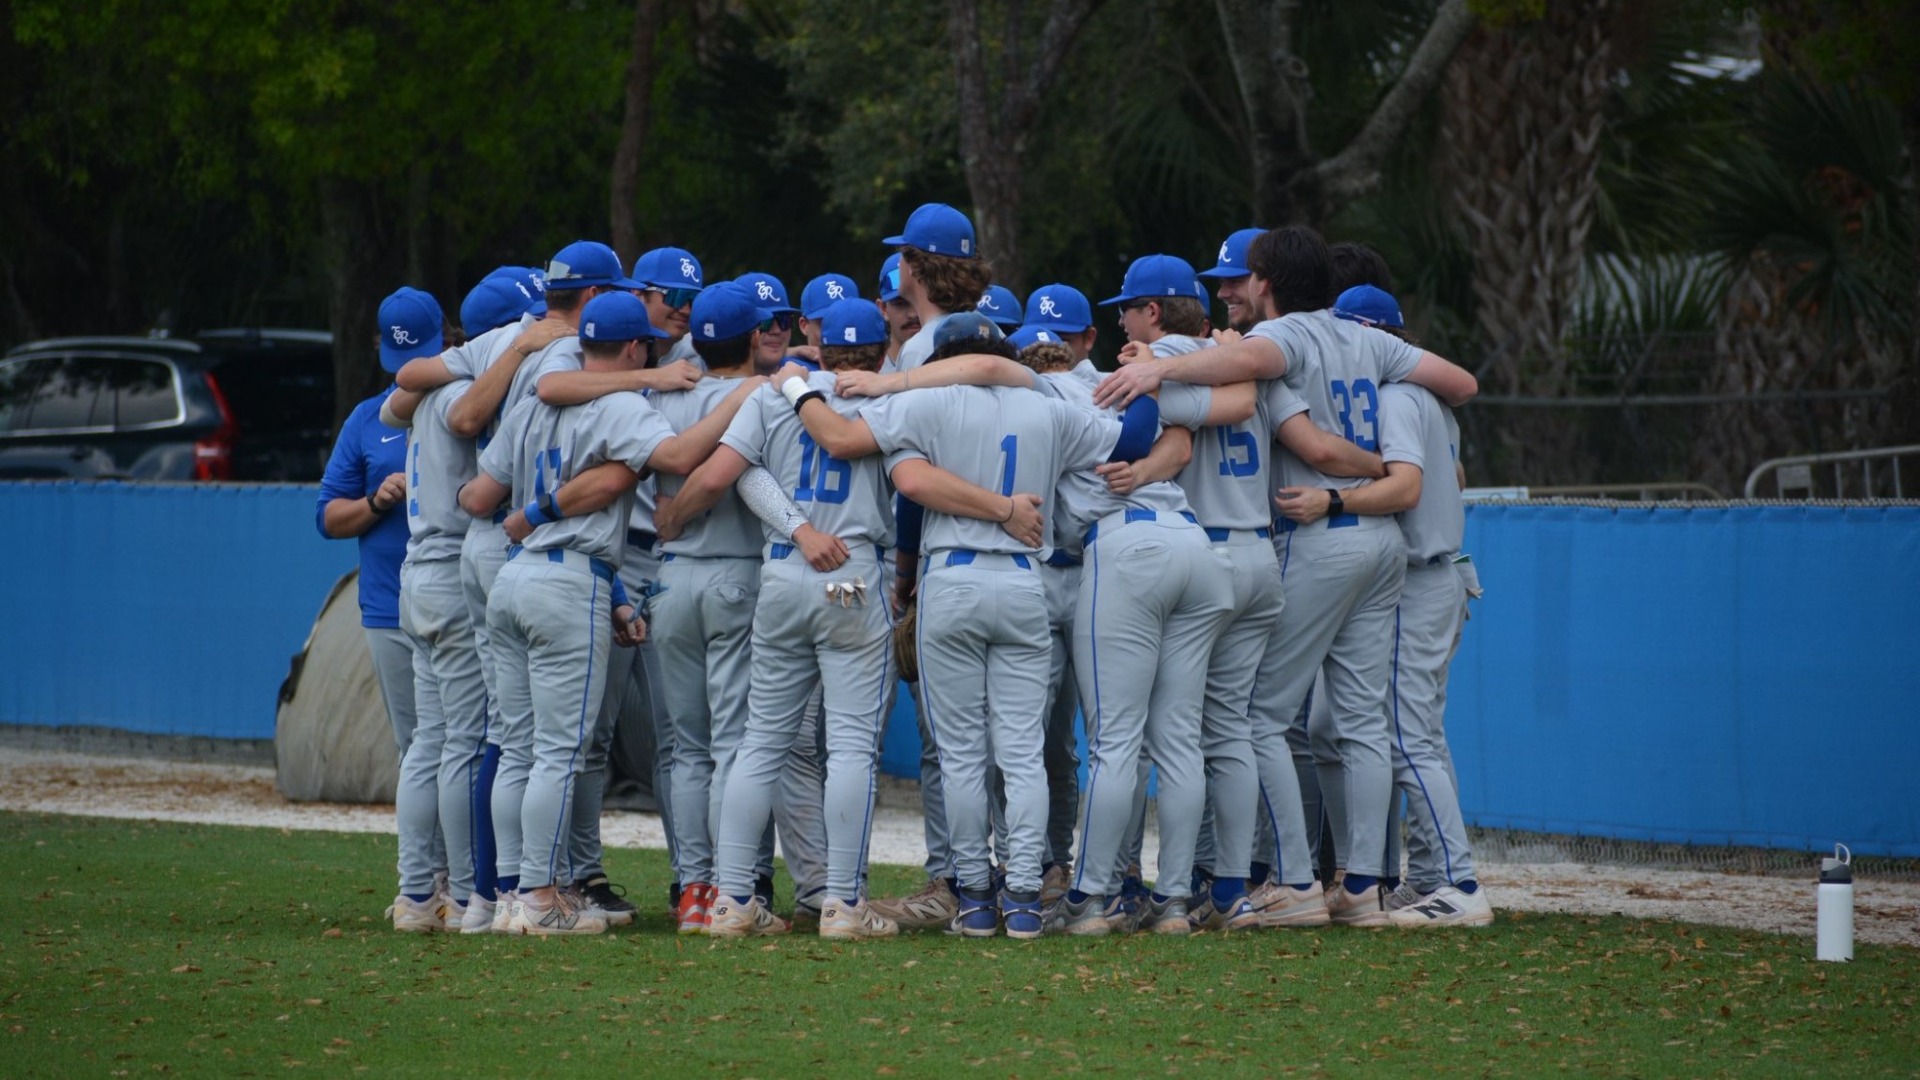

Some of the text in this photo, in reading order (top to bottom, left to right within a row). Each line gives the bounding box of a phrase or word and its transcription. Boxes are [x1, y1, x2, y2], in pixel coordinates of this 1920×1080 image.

[680, 257, 700, 282] ER
[755, 281, 781, 302] ER
[1040, 295, 1062, 318] ER
[391, 325, 418, 345] ER
[1331, 378, 1379, 452] 33
[794, 429, 853, 505] 16
[1001, 434, 1017, 497] 1
